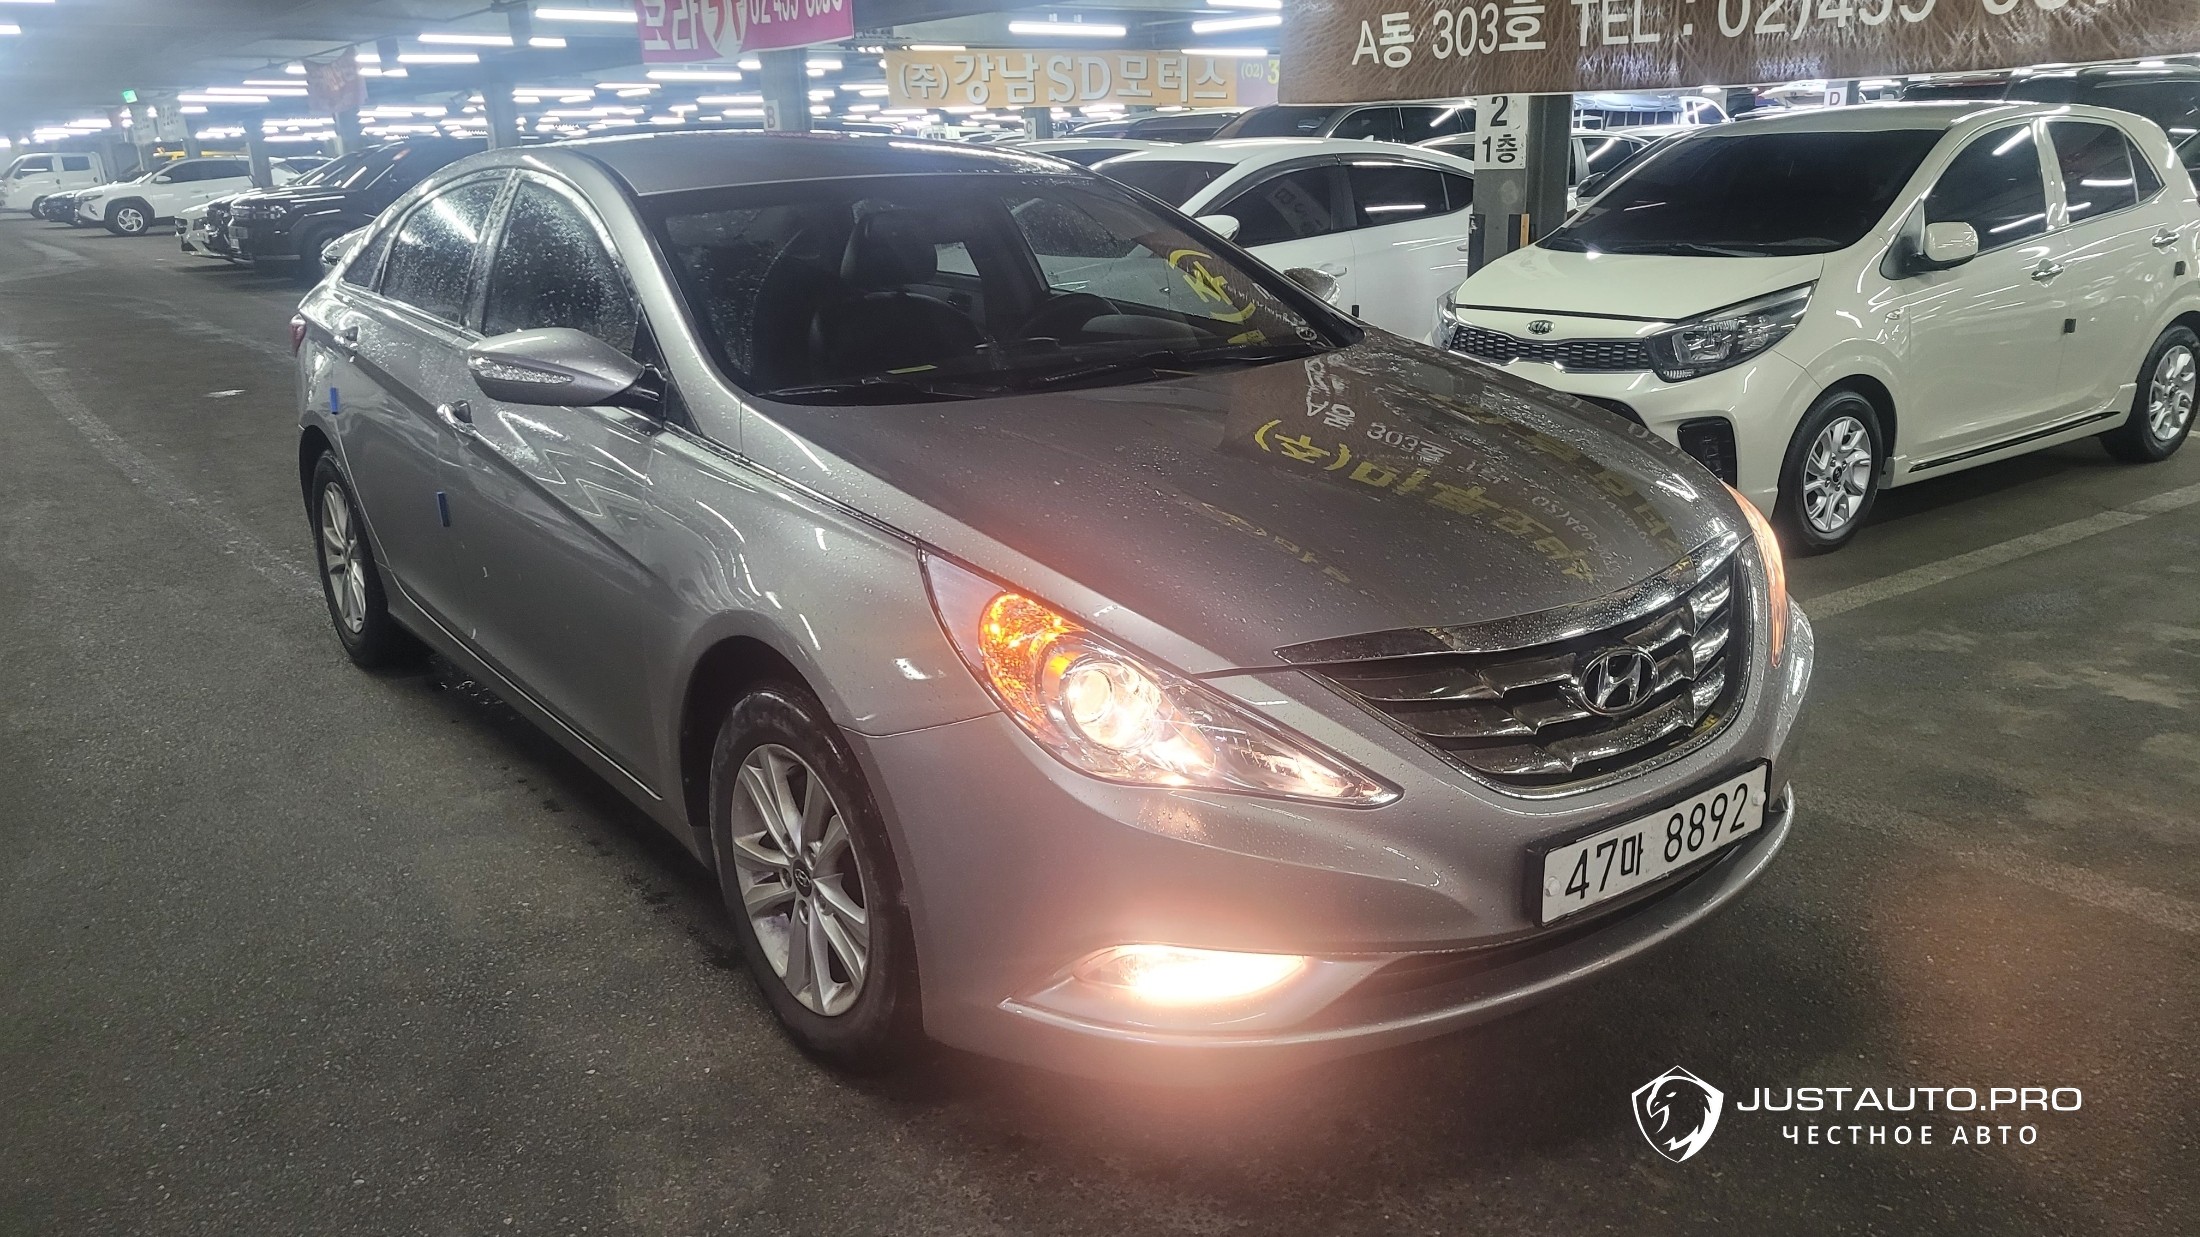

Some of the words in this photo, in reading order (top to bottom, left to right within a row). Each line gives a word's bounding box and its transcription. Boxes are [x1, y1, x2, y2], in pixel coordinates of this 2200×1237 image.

[1351, 11, 1414, 68] A동
[1432, 0, 1547, 60] 303호
[1571, 0, 1661, 47] TEL
[1490, 95, 1509, 127] 2
[1829, 91, 1841, 106] D
[1482, 133, 1518, 163] 1층
[1564, 831, 1644, 900] 47마
[1663, 782, 1748, 863] 8892
